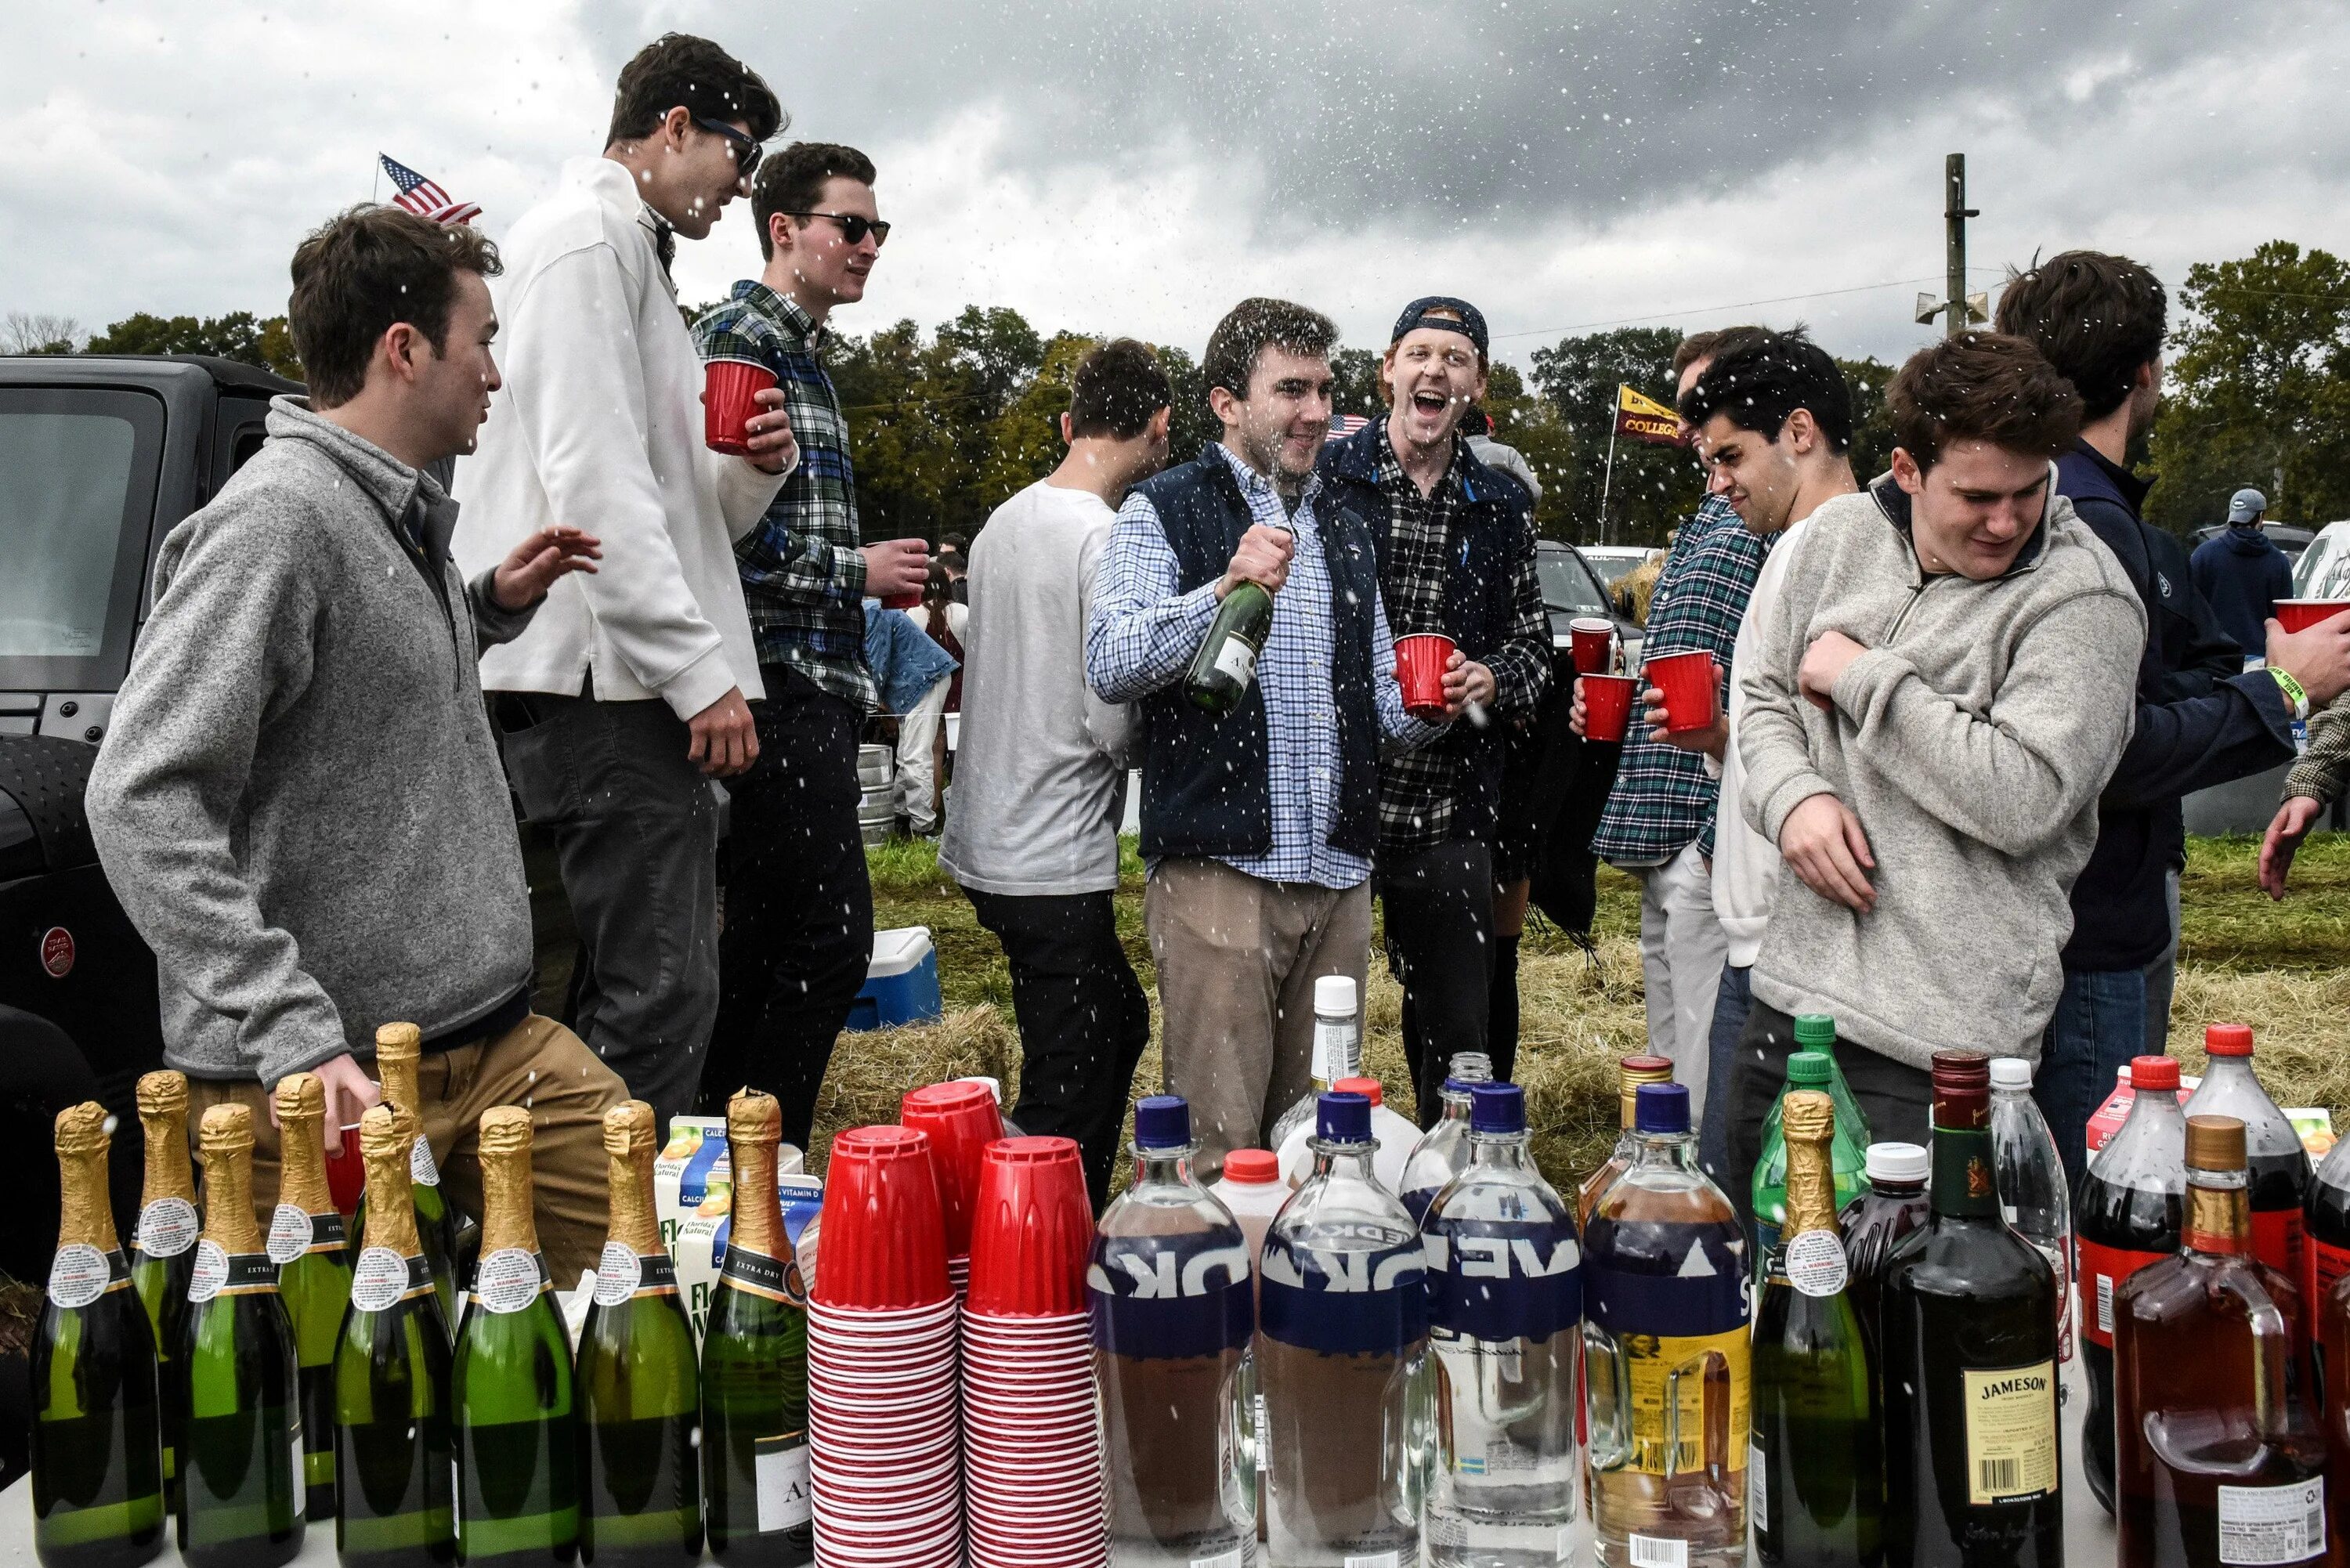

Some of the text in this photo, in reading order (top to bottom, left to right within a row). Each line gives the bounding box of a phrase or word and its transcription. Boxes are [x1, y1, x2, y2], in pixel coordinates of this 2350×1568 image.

[2283, 674, 2304, 697] VERIFIED
[2283, 684, 2295, 693] AGE
[783, 1189, 812, 1198] VITAMIN
[683, 1227, 713, 1237] Natural
[736, 1261, 780, 1279] EXTRA DRY
[1982, 1378, 2046, 1400] JAMESON
